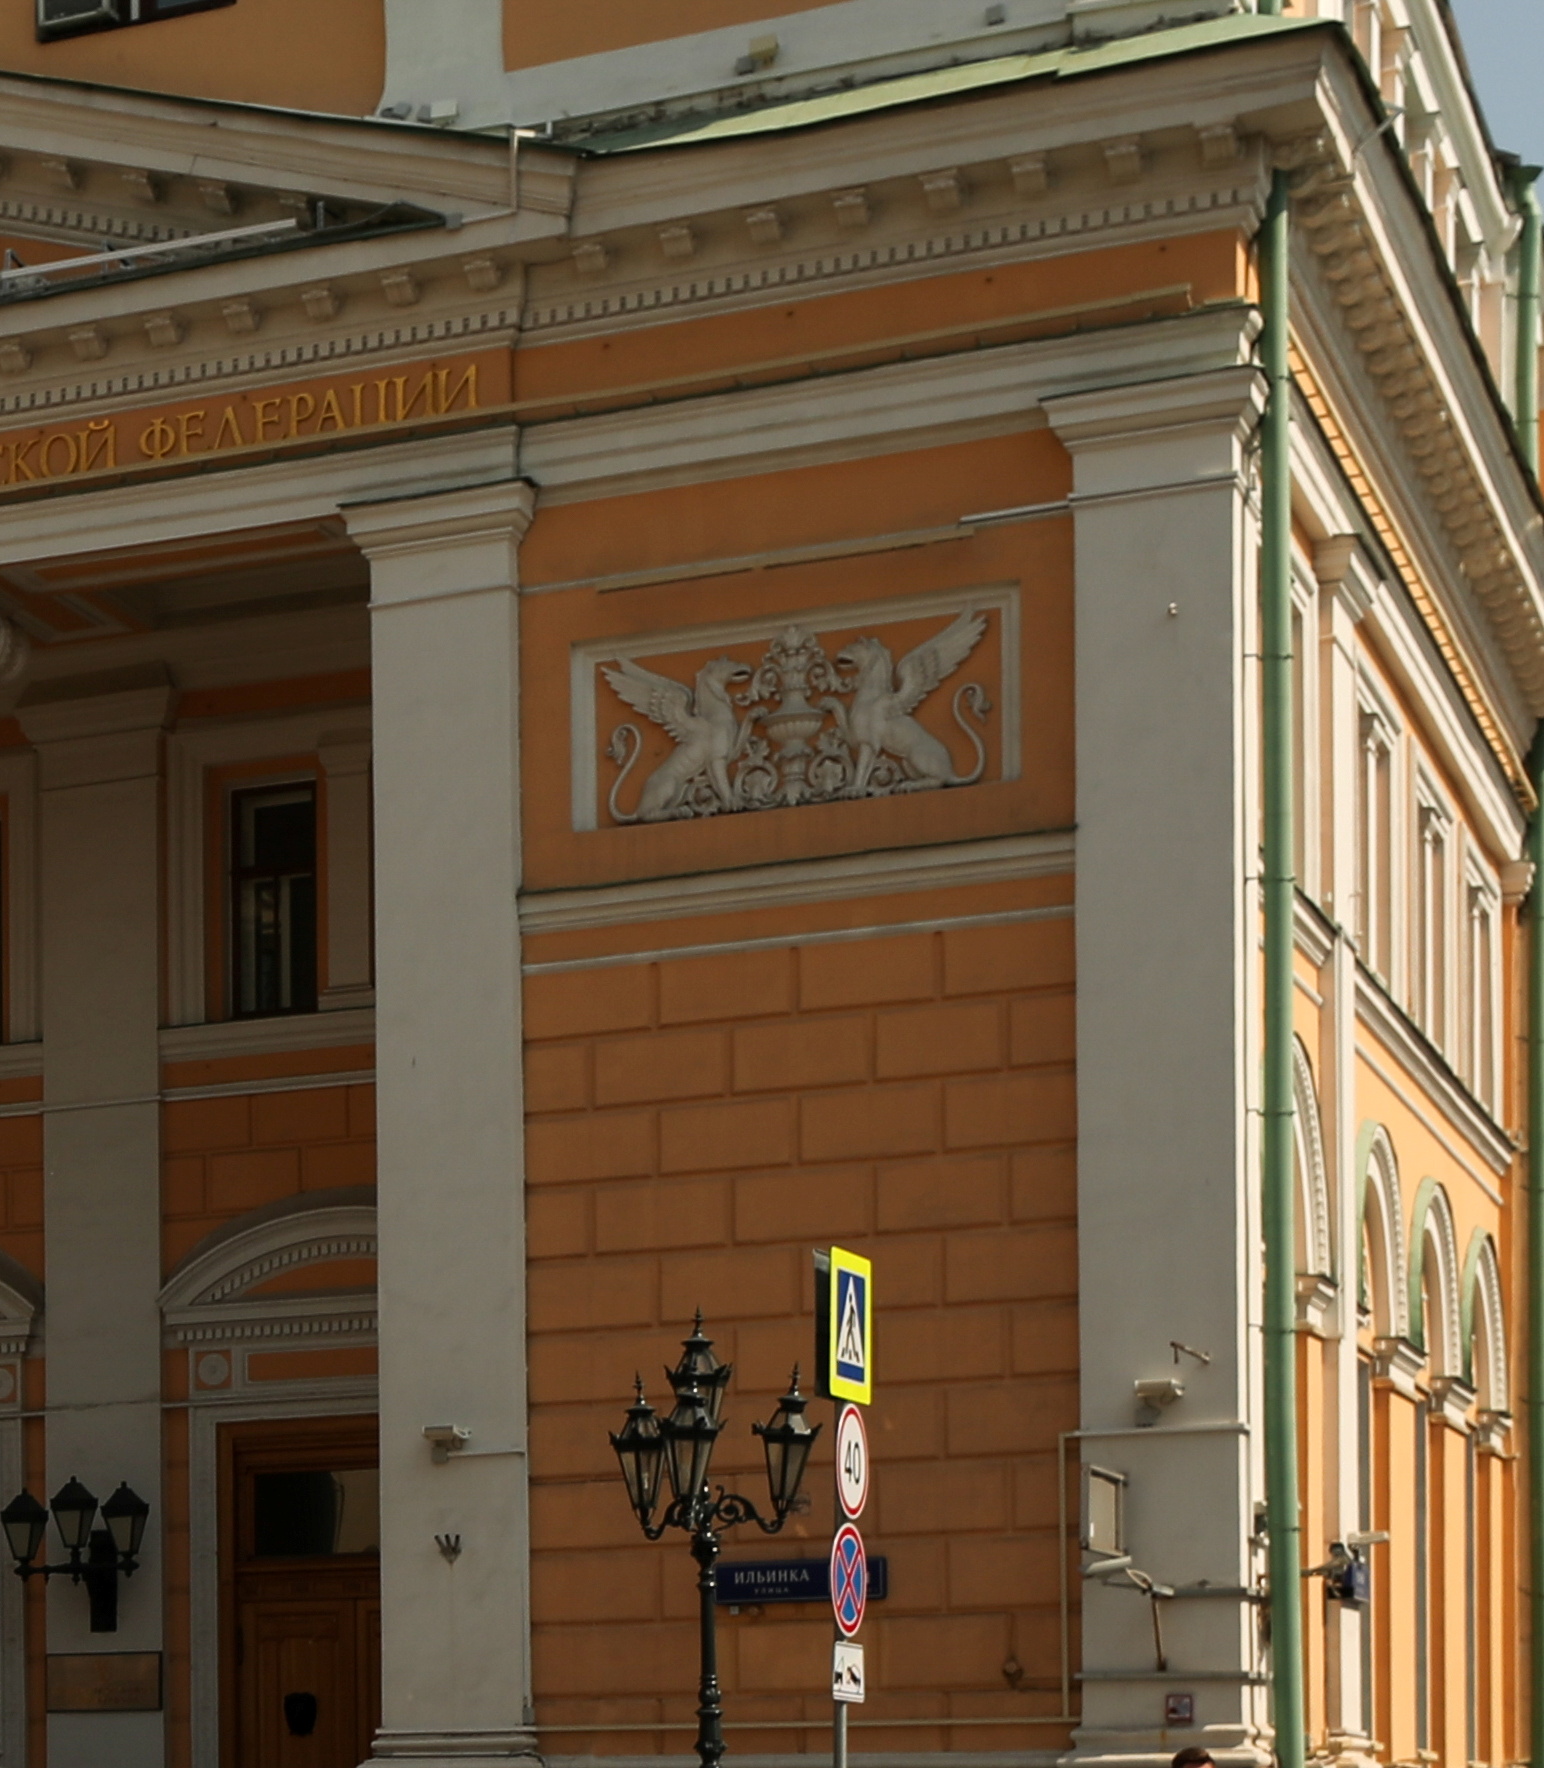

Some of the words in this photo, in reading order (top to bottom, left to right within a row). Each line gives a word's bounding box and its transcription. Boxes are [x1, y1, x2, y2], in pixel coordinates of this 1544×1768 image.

[138, 363, 479, 460] ФЕДЕРАЦИИ
[844, 1439, 861, 1485] 40
[734, 1568, 810, 1585] ИЛЬИНКА
